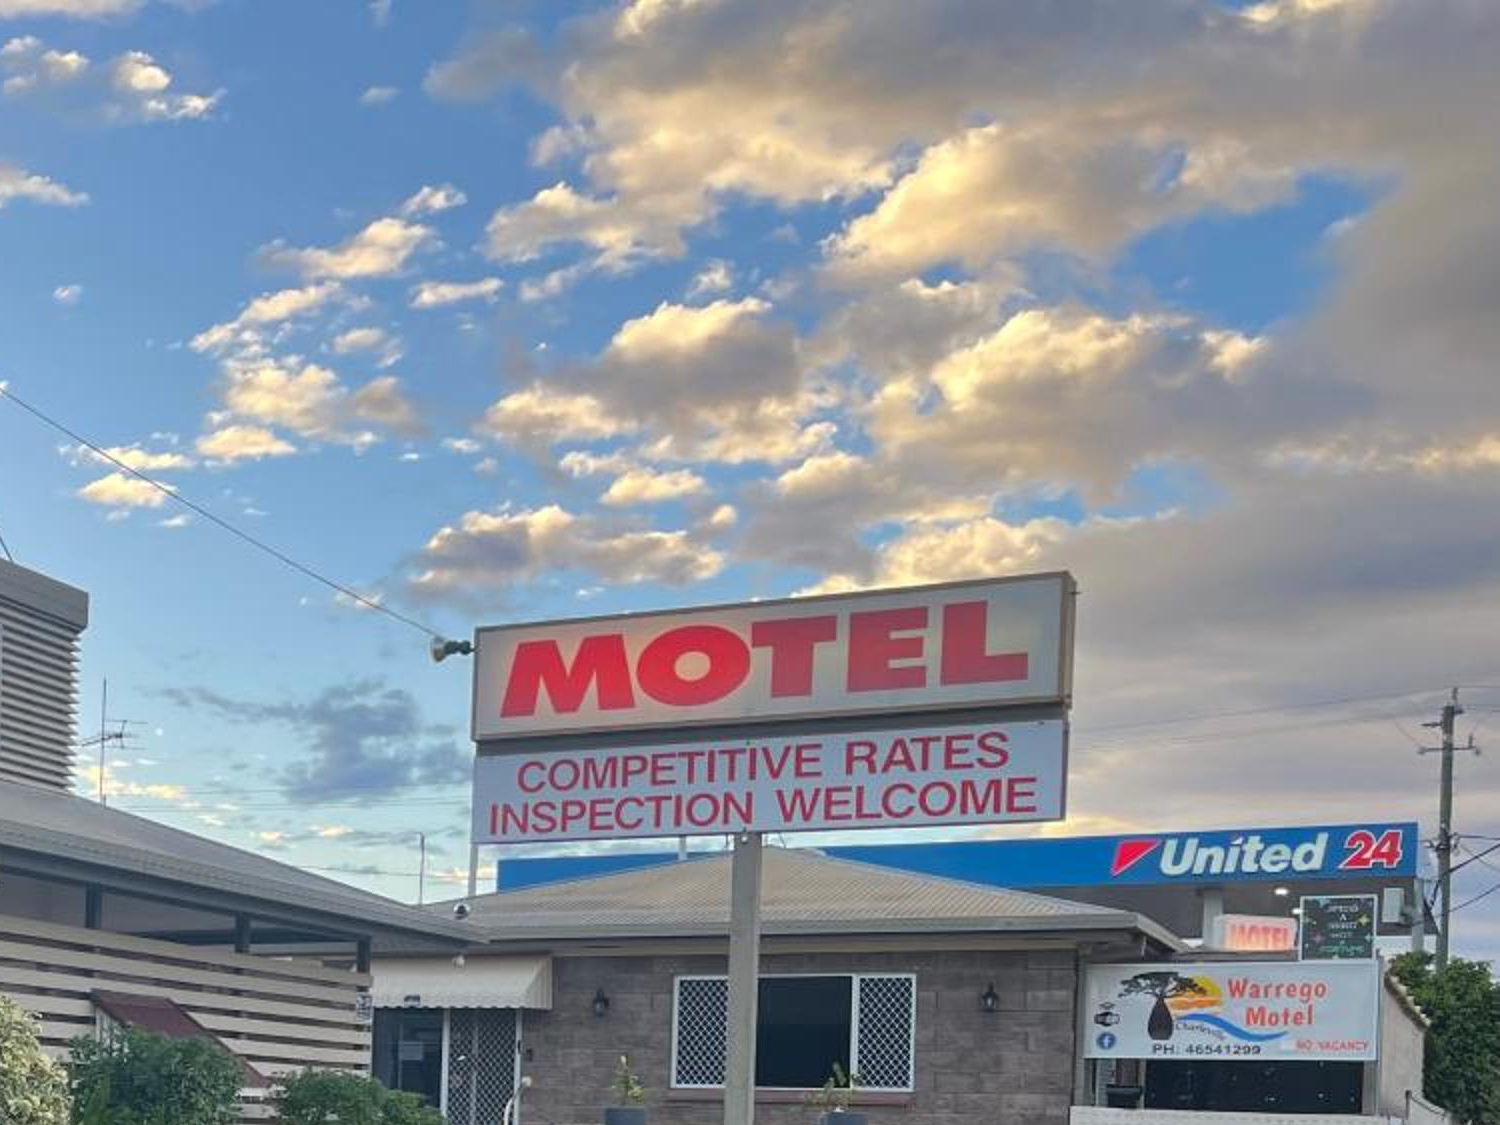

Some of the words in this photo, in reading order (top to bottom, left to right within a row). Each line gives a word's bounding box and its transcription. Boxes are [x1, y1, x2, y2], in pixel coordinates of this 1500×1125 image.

[500, 601, 1029, 718] MOTEL
[517, 743, 823, 793] COMPETITIVE
[845, 731, 1010, 776] RATES
[489, 790, 755, 835] INSPECTION
[776, 776, 1038, 823] WELCOME
[1159, 832, 1329, 877] United
[1338, 829, 1403, 871] 24
[1229, 923, 1293, 949] MOTEL
[1227, 978, 1329, 1009] Warrego
[1246, 1004, 1314, 1027] Motel
[1152, 1043, 1180, 1055] PH:
[1185, 1044, 1262, 1056] 46541299
